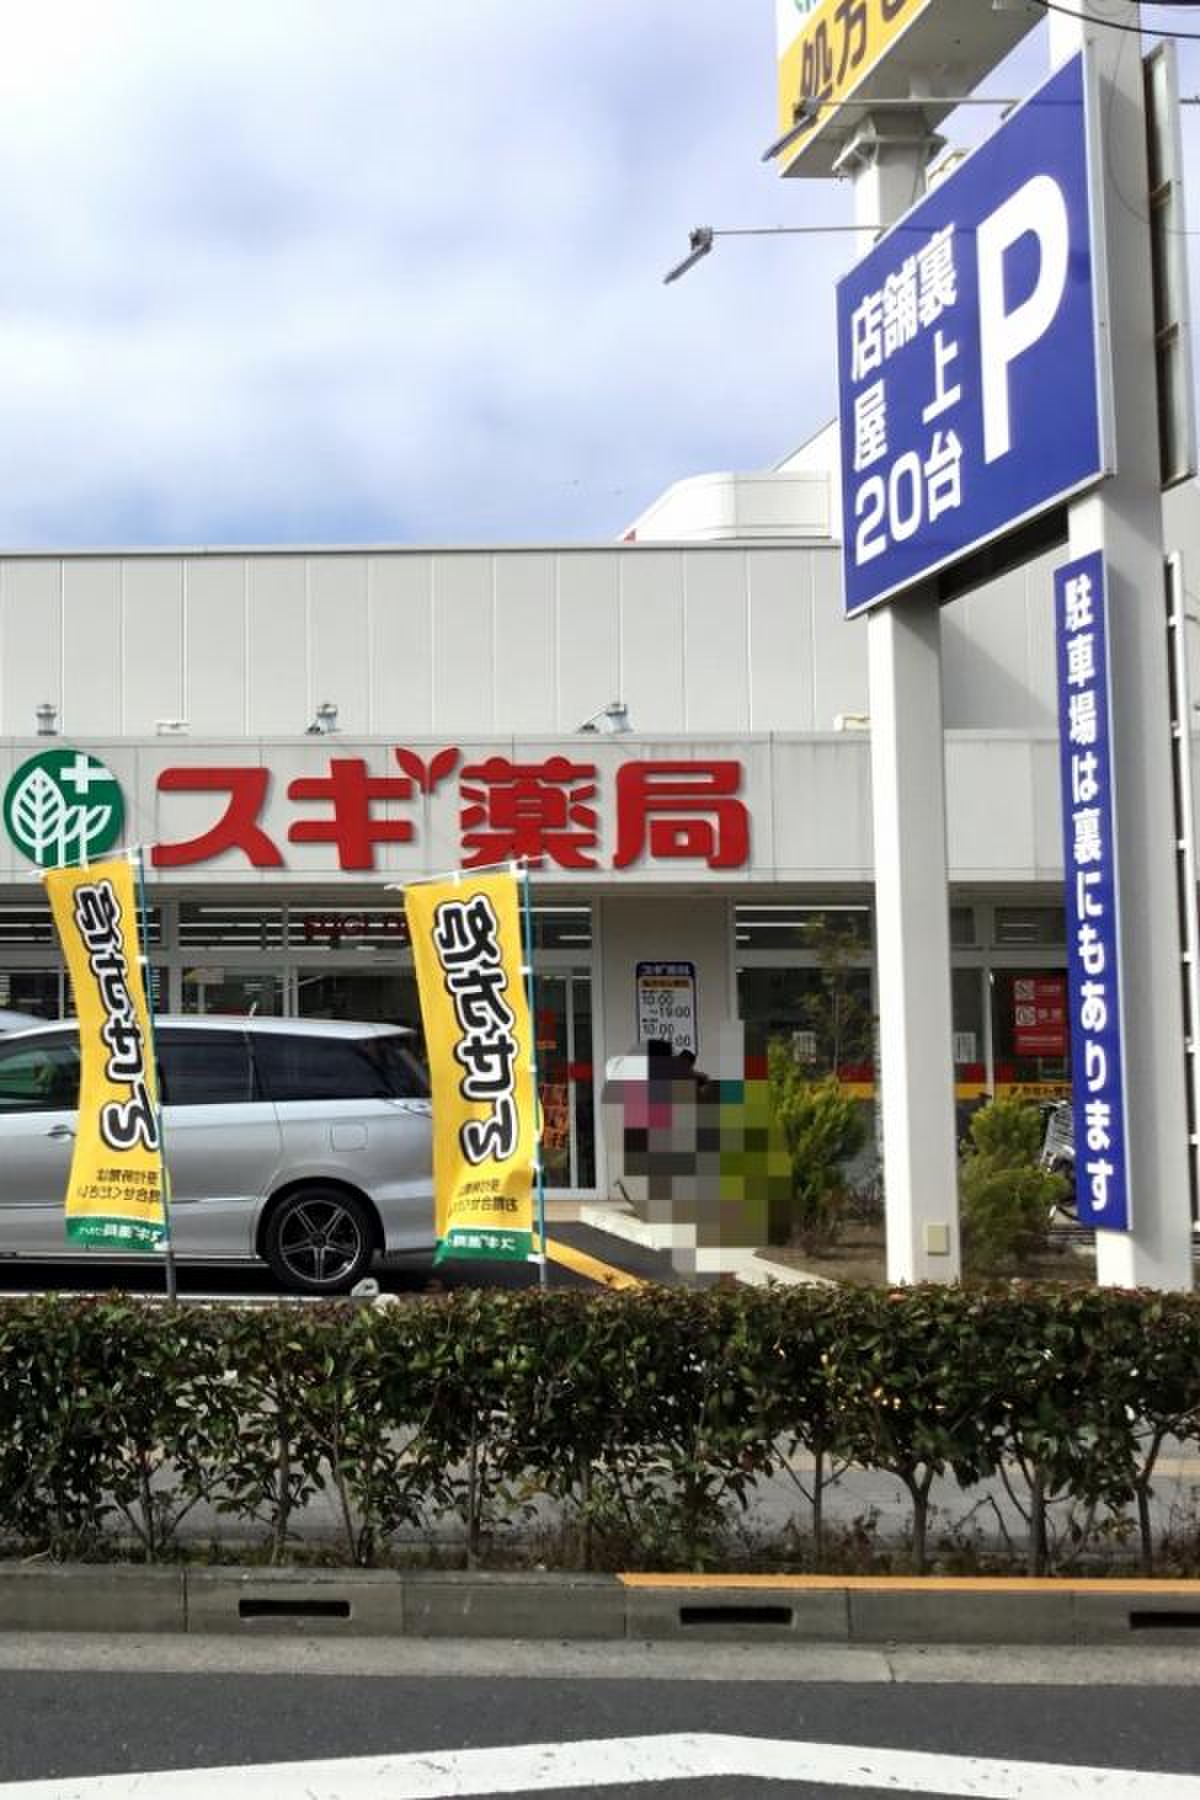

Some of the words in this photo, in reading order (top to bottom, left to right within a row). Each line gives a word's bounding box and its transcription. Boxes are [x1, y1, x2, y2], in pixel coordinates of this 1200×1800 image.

[850, 222, 959, 384] 店舗裏
[975, 174, 1070, 465] P
[854, 430, 963, 567] 20台
[151, 747, 751, 870] スギ薬局
[1064, 573, 1115, 1212] 駐車場は裏にもあります
